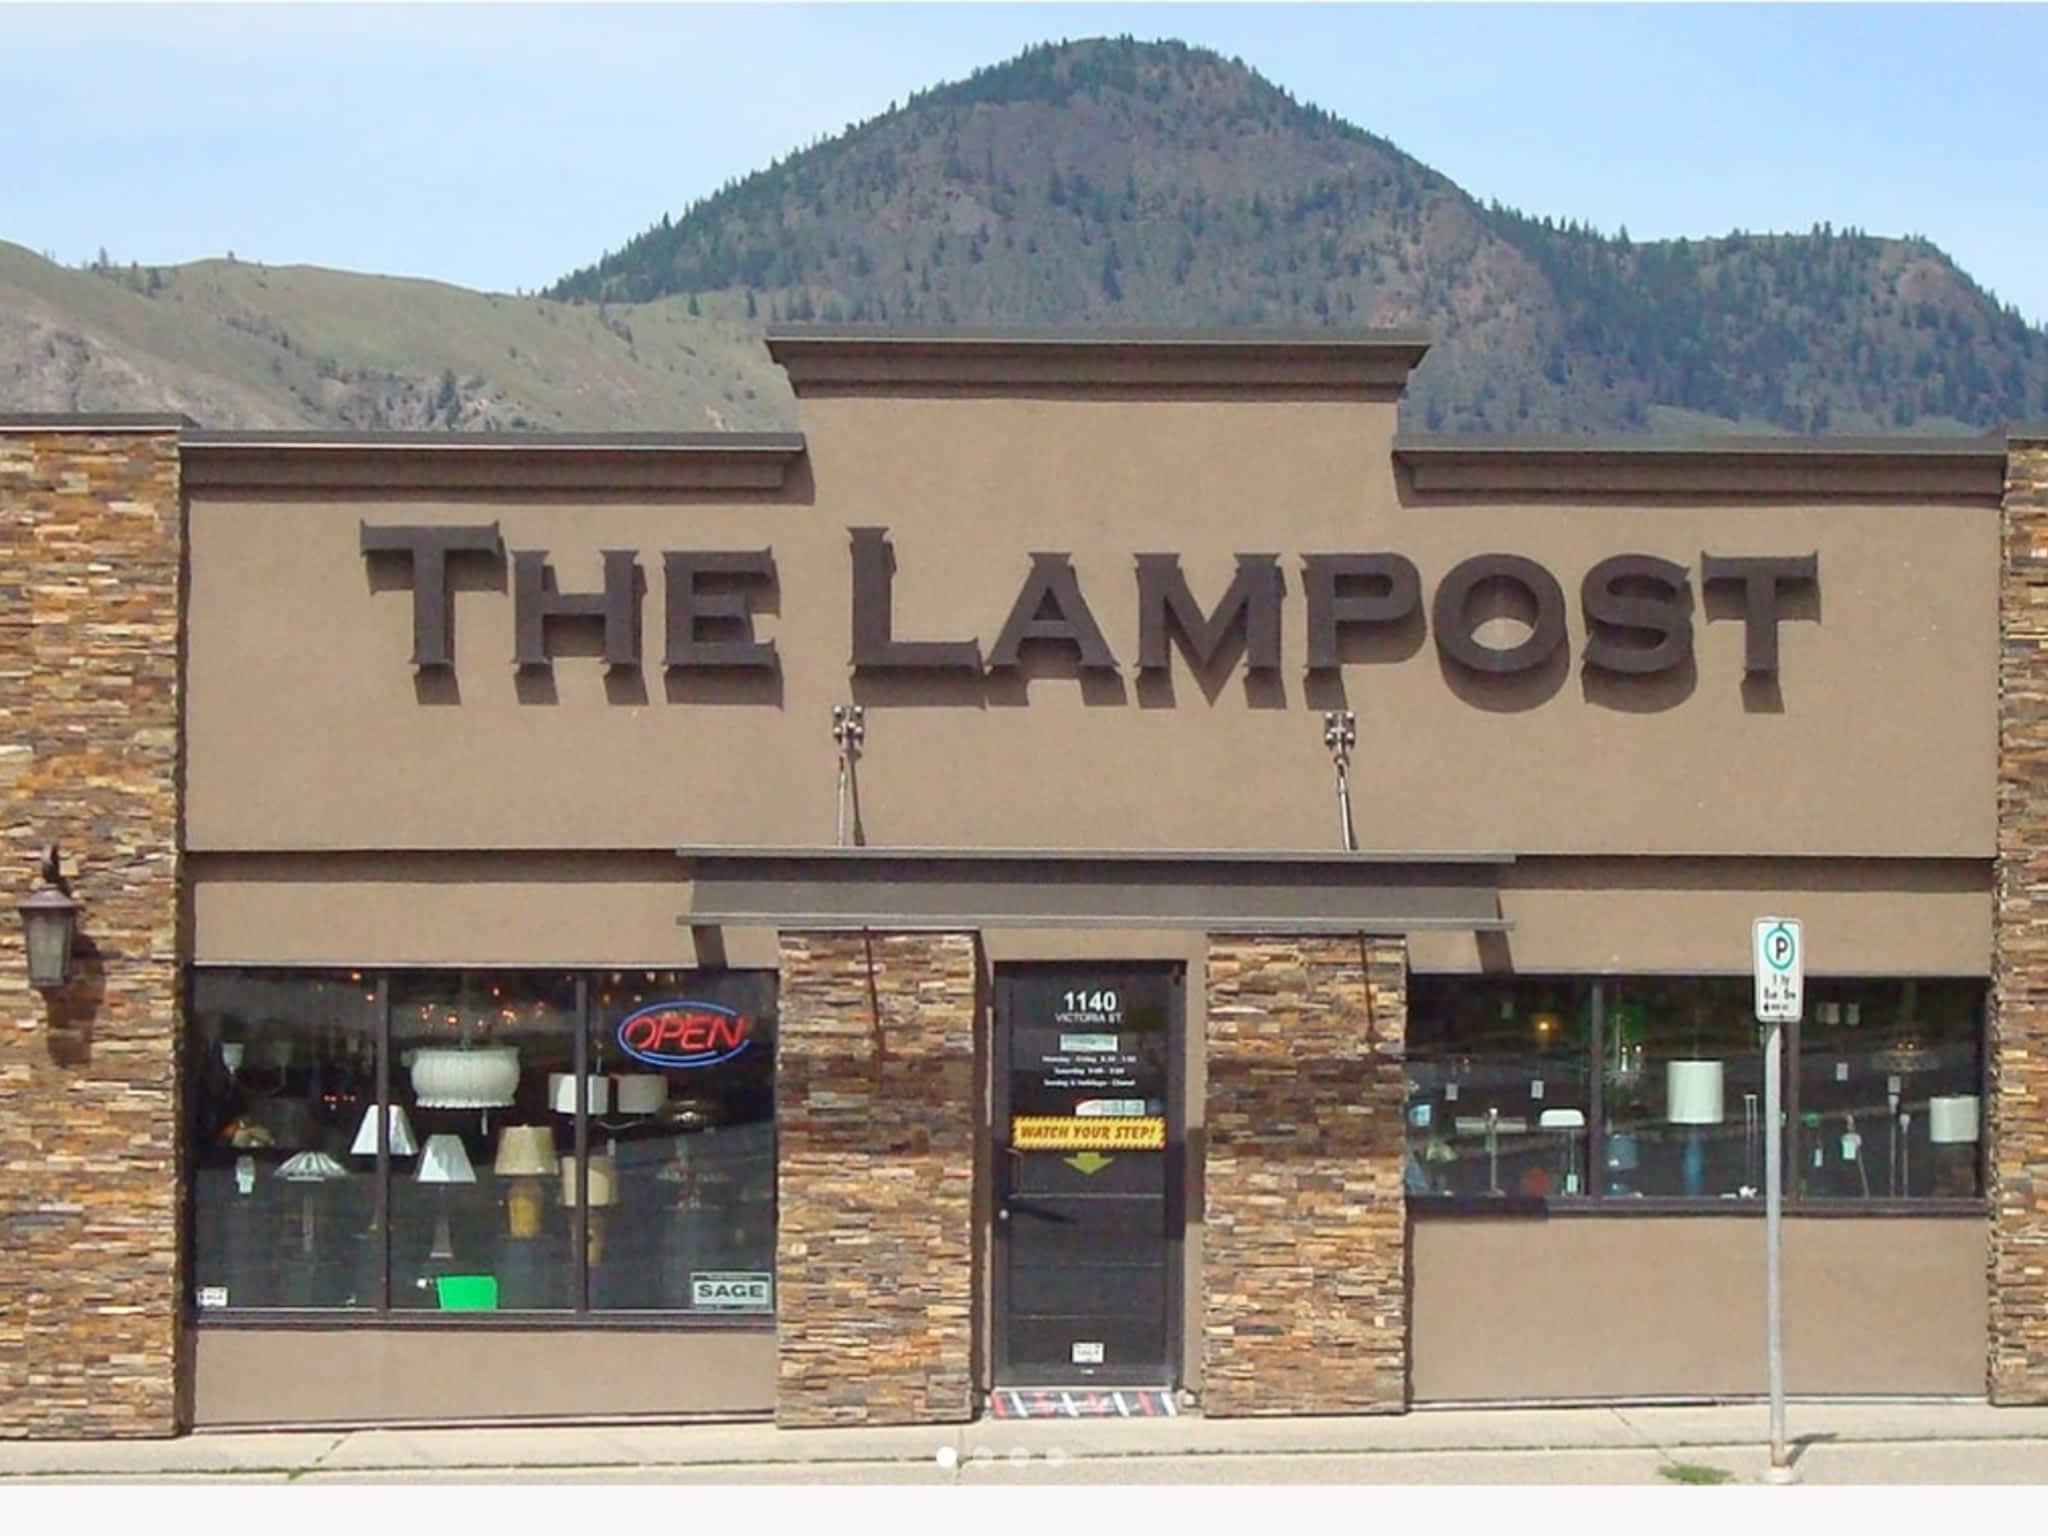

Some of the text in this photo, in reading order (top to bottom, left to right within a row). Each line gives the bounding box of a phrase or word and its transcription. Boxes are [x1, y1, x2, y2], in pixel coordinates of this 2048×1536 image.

[361, 520, 1819, 674] THE LAMPOST
[1063, 991, 1117, 1011] 1140
[1055, 1012, 1106, 1023] VICTORIA
[625, 1014, 748, 1050] OPEN
[1021, 1126, 1156, 1138] WATCH YOUR STEP!
[698, 1284, 765, 1297] SAGE
